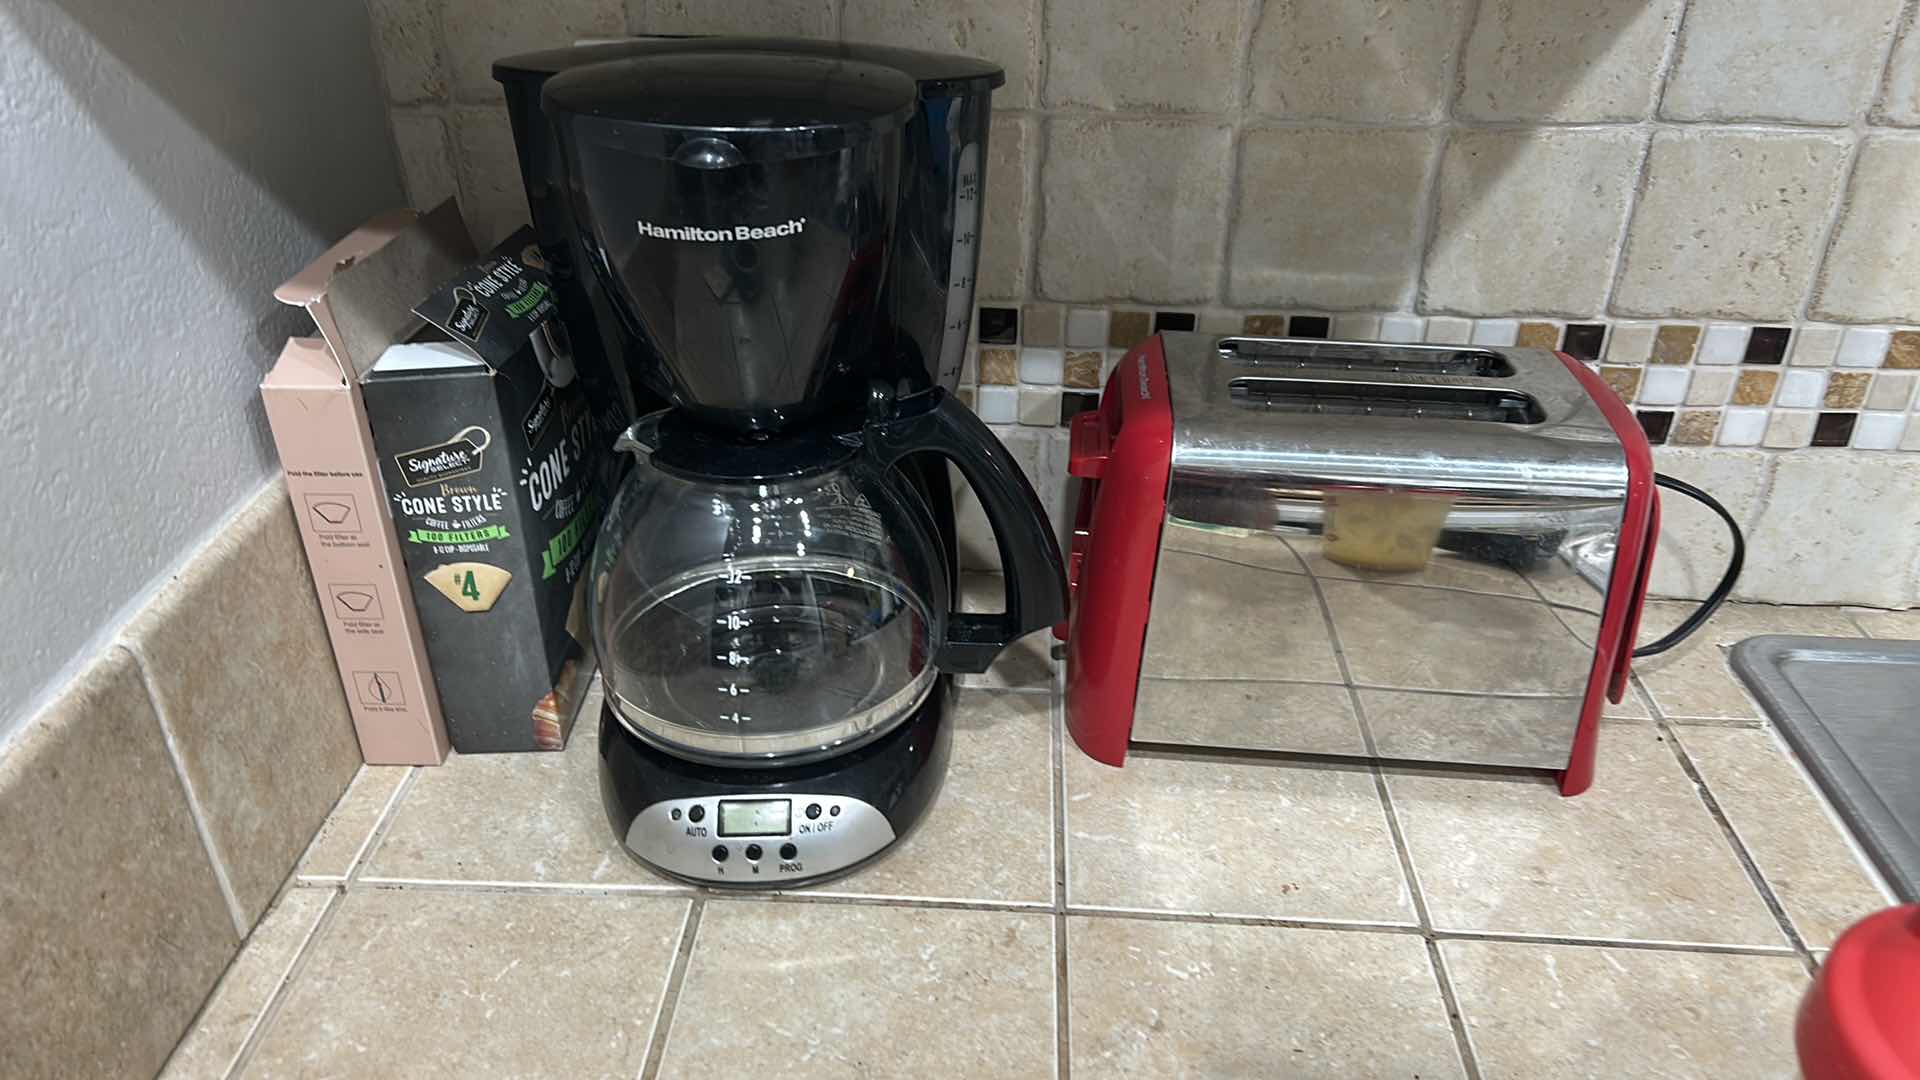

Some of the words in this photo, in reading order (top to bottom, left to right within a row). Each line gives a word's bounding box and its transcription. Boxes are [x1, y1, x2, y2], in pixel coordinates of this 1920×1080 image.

[637, 220, 733, 242] Hamilton
[734, 219, 804, 241] Beach
[473, 272, 503, 298] CONE
[494, 259, 523, 283] STYLE
[408, 450, 468, 474] Signature
[528, 438, 570, 512] CONE
[440, 483, 478, 497] Brown
[401, 496, 447, 515] CONE
[451, 493, 503, 513] STYLE
[425, 516, 450, 530] COFFEE
[462, 513, 488, 529] FILTERS
[427, 532, 445, 541] 100
[448, 529, 491, 542] FILTERS
[727, 569, 742, 585] 12
[727, 615, 741, 631] 10
[728, 651, 737, 666] 8
[730, 683, 738, 696] 6
[731, 712, 739, 725] 4
[686, 827, 708, 838] AUTO
[752, 867, 760, 875] M
[779, 864, 804, 873] PROG
